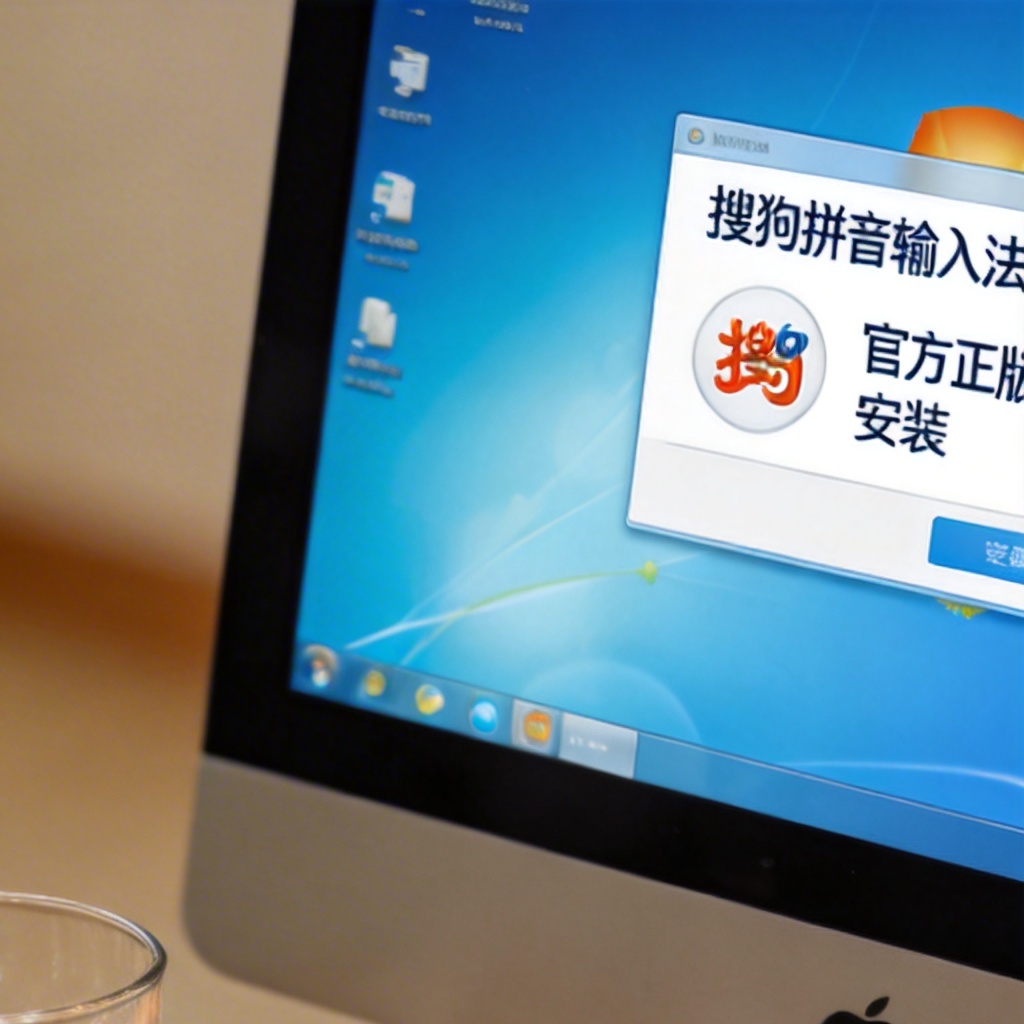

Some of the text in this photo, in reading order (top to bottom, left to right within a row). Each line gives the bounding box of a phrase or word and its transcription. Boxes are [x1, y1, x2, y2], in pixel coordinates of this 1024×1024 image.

[706, 184, 1024, 292] 搜狗拼音输入法
[854, 392, 950, 457] 安装
